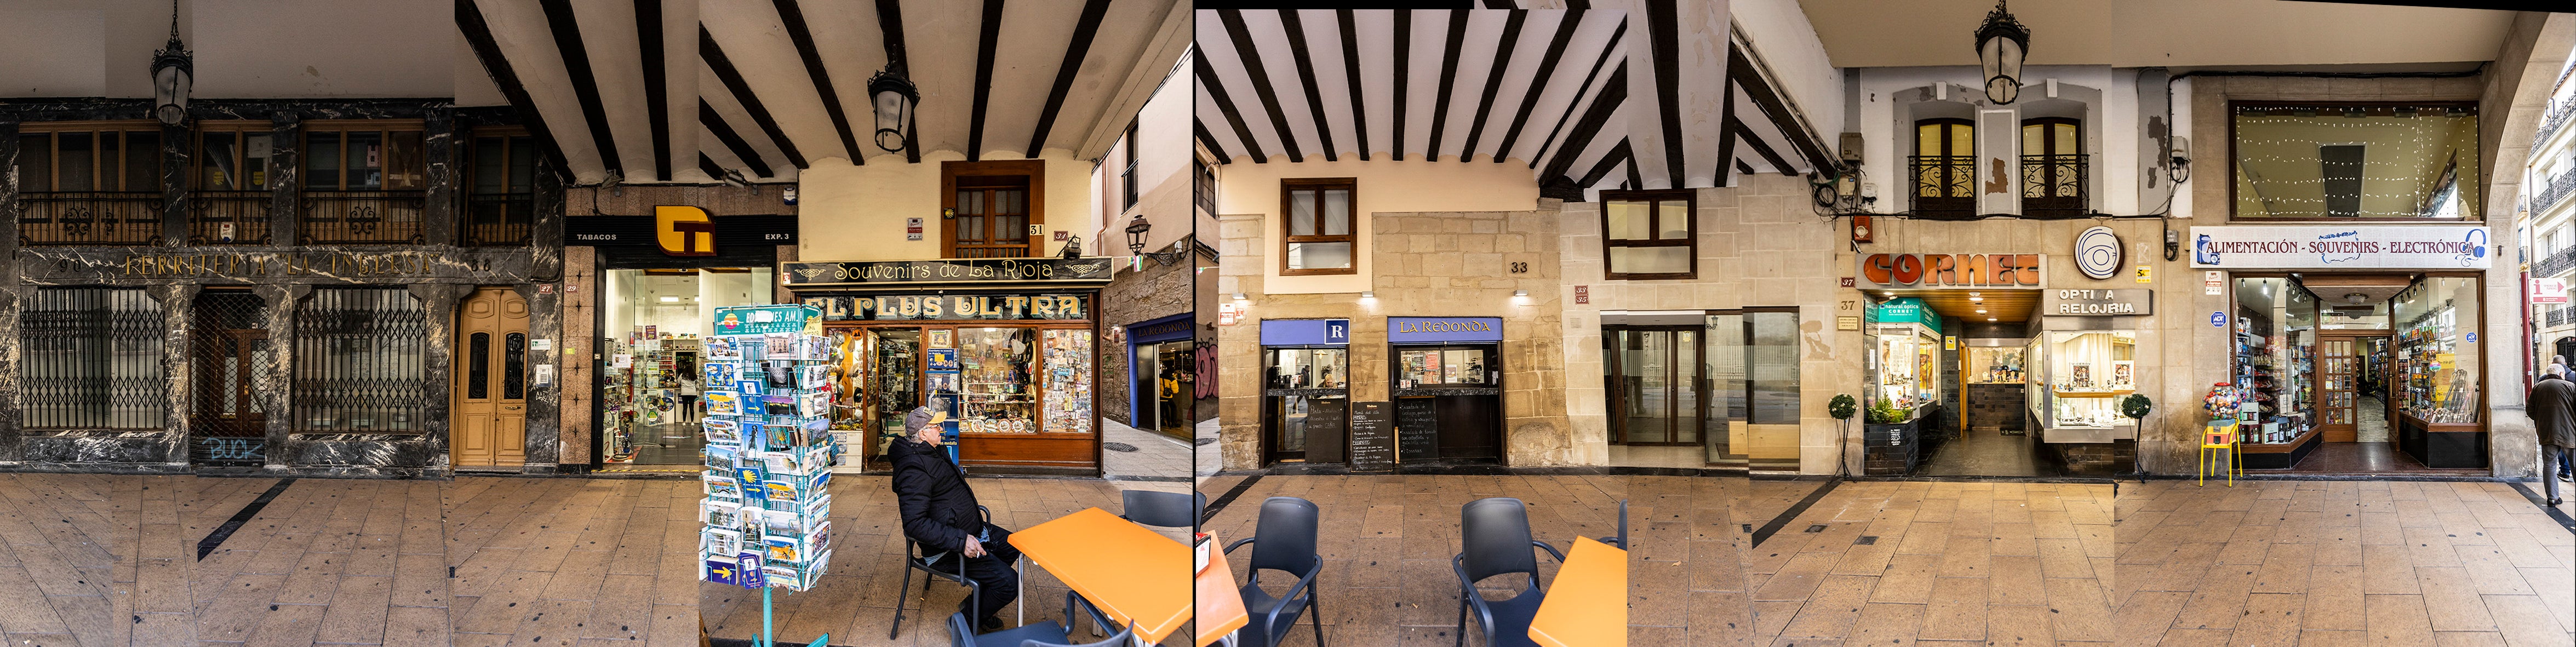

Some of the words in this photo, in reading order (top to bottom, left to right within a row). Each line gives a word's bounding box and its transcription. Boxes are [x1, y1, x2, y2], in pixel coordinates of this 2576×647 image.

[1031, 225, 1042, 235] 31
[2206, 239, 2298, 253] ALIMENTACIÓN
[2309, 242, 2379, 254] SOUVENIRS
[2390, 239, 2476, 254] ELECTRÓNICA
[59, 259, 82, 273] 90
[126, 255, 266, 275] FERRETERIA
[471, 259, 491, 272] 88
[834, 262, 931, 280] Souvenirs
[940, 260, 961, 278] de
[969, 259, 994, 277] La
[1002, 259, 1054, 280] Rioja
[1511, 262, 1527, 273] 33
[2059, 289, 2113, 299] OPTIA
[853, 296, 944, 319] PLUS
[954, 296, 1082, 318] ULTRA
[1841, 300, 1855, 310] 37
[2059, 303, 2135, 314] RELOJERIA
[1149, 321, 1191, 336] REDONDA
[1331, 325, 1343, 338] R
[1400, 321, 1418, 333] LA
[1421, 320, 1491, 333] REDONDA
[202, 437, 265, 459] BUCK
